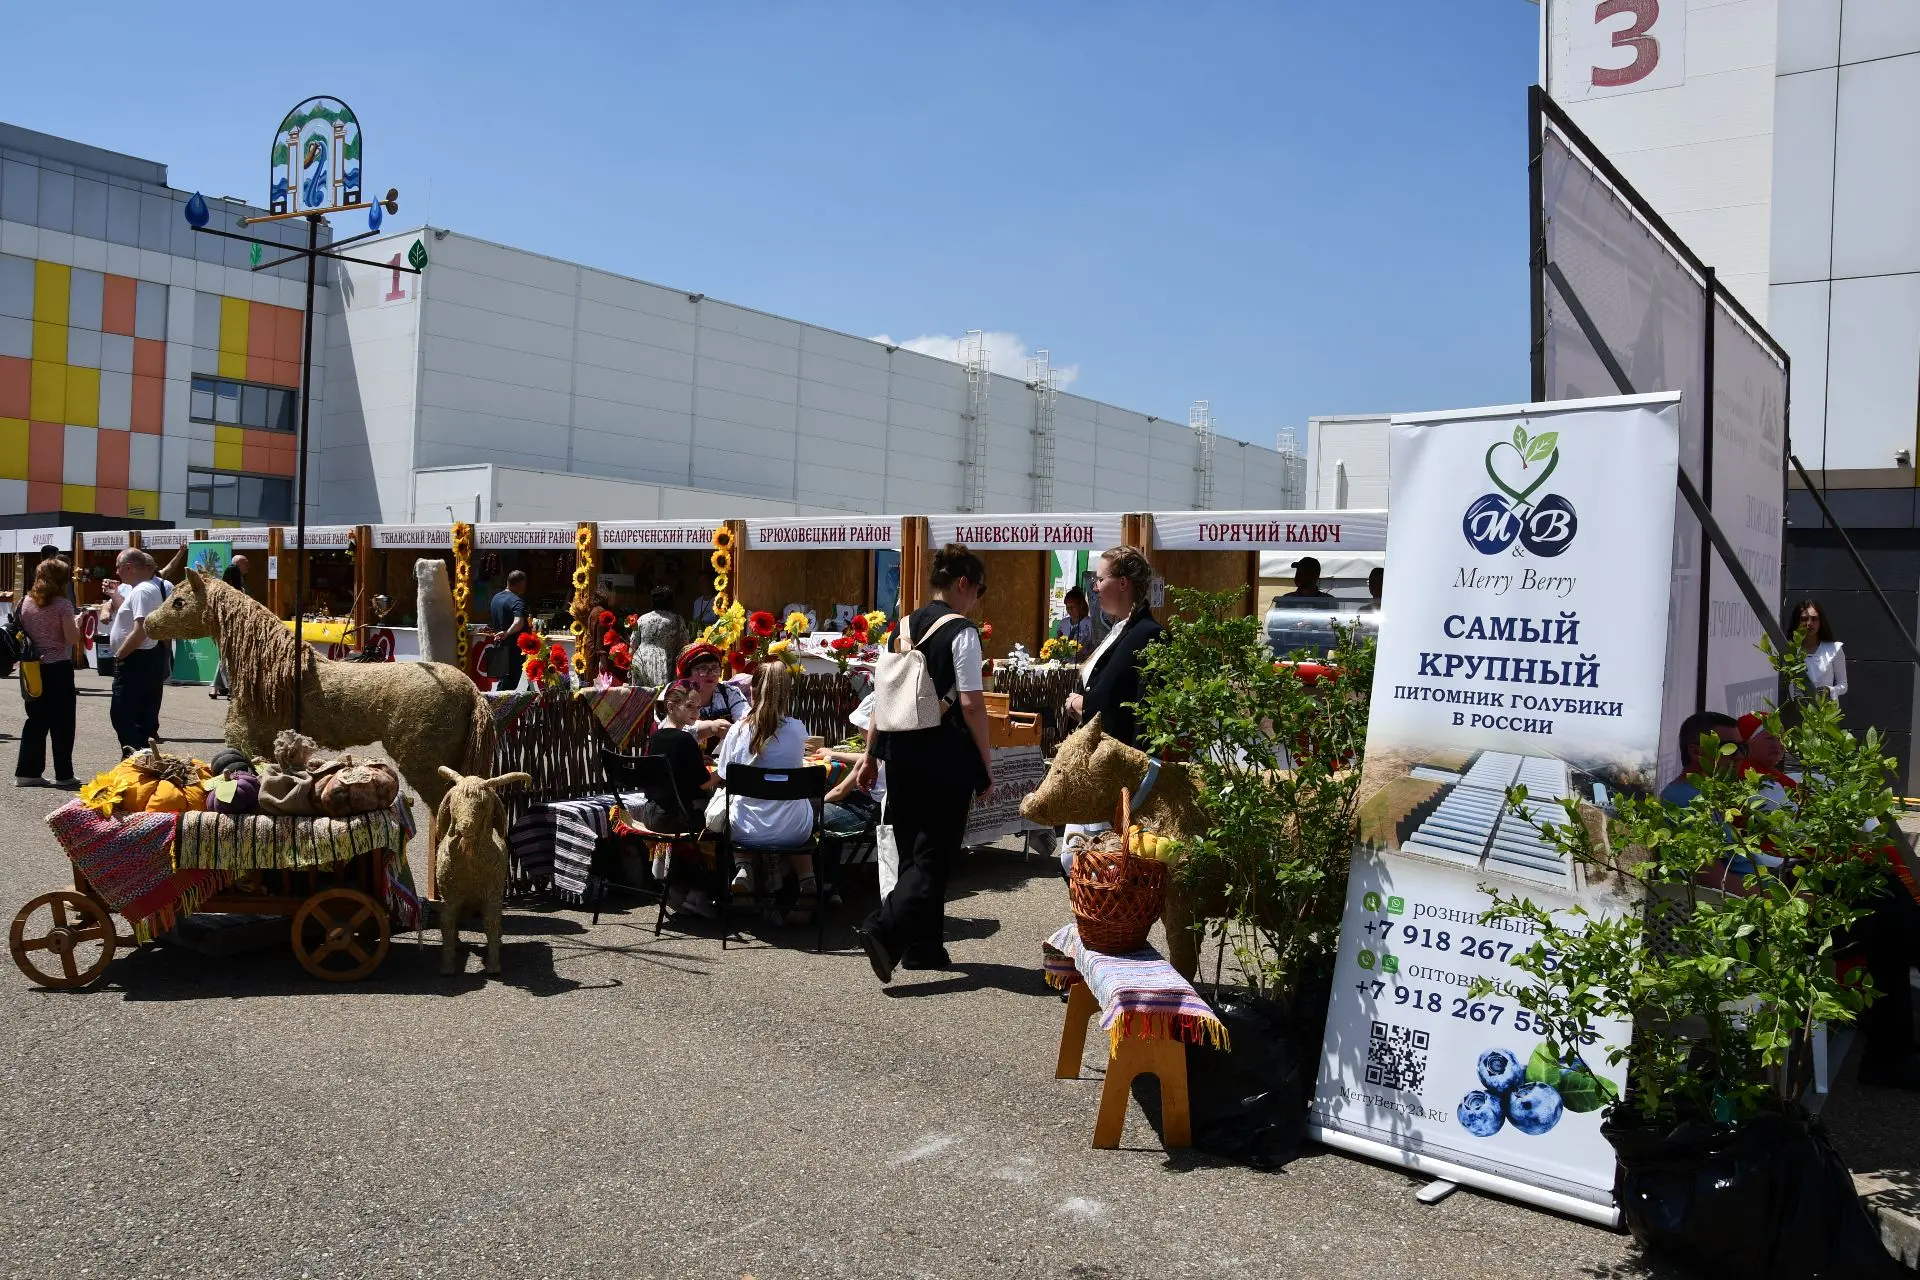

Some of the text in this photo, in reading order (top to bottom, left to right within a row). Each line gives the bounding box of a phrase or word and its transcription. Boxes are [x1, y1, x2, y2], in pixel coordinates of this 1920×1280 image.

[1591, 0, 1660, 87] 3
[385, 252, 406, 302] 1
[290, 532, 350, 544] КОНОВСКИЙ РАЙО
[380, 529, 450, 544] ТБИЛИССКИЙ РАЙОН
[479, 528, 576, 544] БЕЛОРЕЧЕНСКИЙ РАЙОН
[603, 526, 716, 544] БЕЛОРЕЧЕНСКИЙ РАЙО
[759, 524, 892, 544] БРЮХОВЕЦКИЙ РАЙОН
[955, 523, 1094, 543] КАНЕВСКОЙ РАЙОН
[1198, 520, 1341, 543] ГОРЯЧИЙ КЛЮЧ
[1452, 566, 1578, 598] Merry Berry
[1443, 610, 1581, 645] САМЫЙ
[1417, 652, 1601, 689] КРУПНЫЙ
[1393, 685, 1624, 717] ПИТОМНИК ГОЛУБИКИ
[1452, 711, 1554, 735] В РОССИИ
[1364, 919, 1395, 940] +7
[1403, 925, 1451, 951] 918
[1459, 936, 1514, 963] 267
[1525, 946, 1558, 972] 5
[1356, 979, 1386, 1000] +7
[1394, 985, 1442, 1013] 918
[1451, 998, 1505, 1026] 267
[1514, 1010, 1551, 1036] 55
[1339, 1085, 1448, 1123] MerryBerry23.RU
